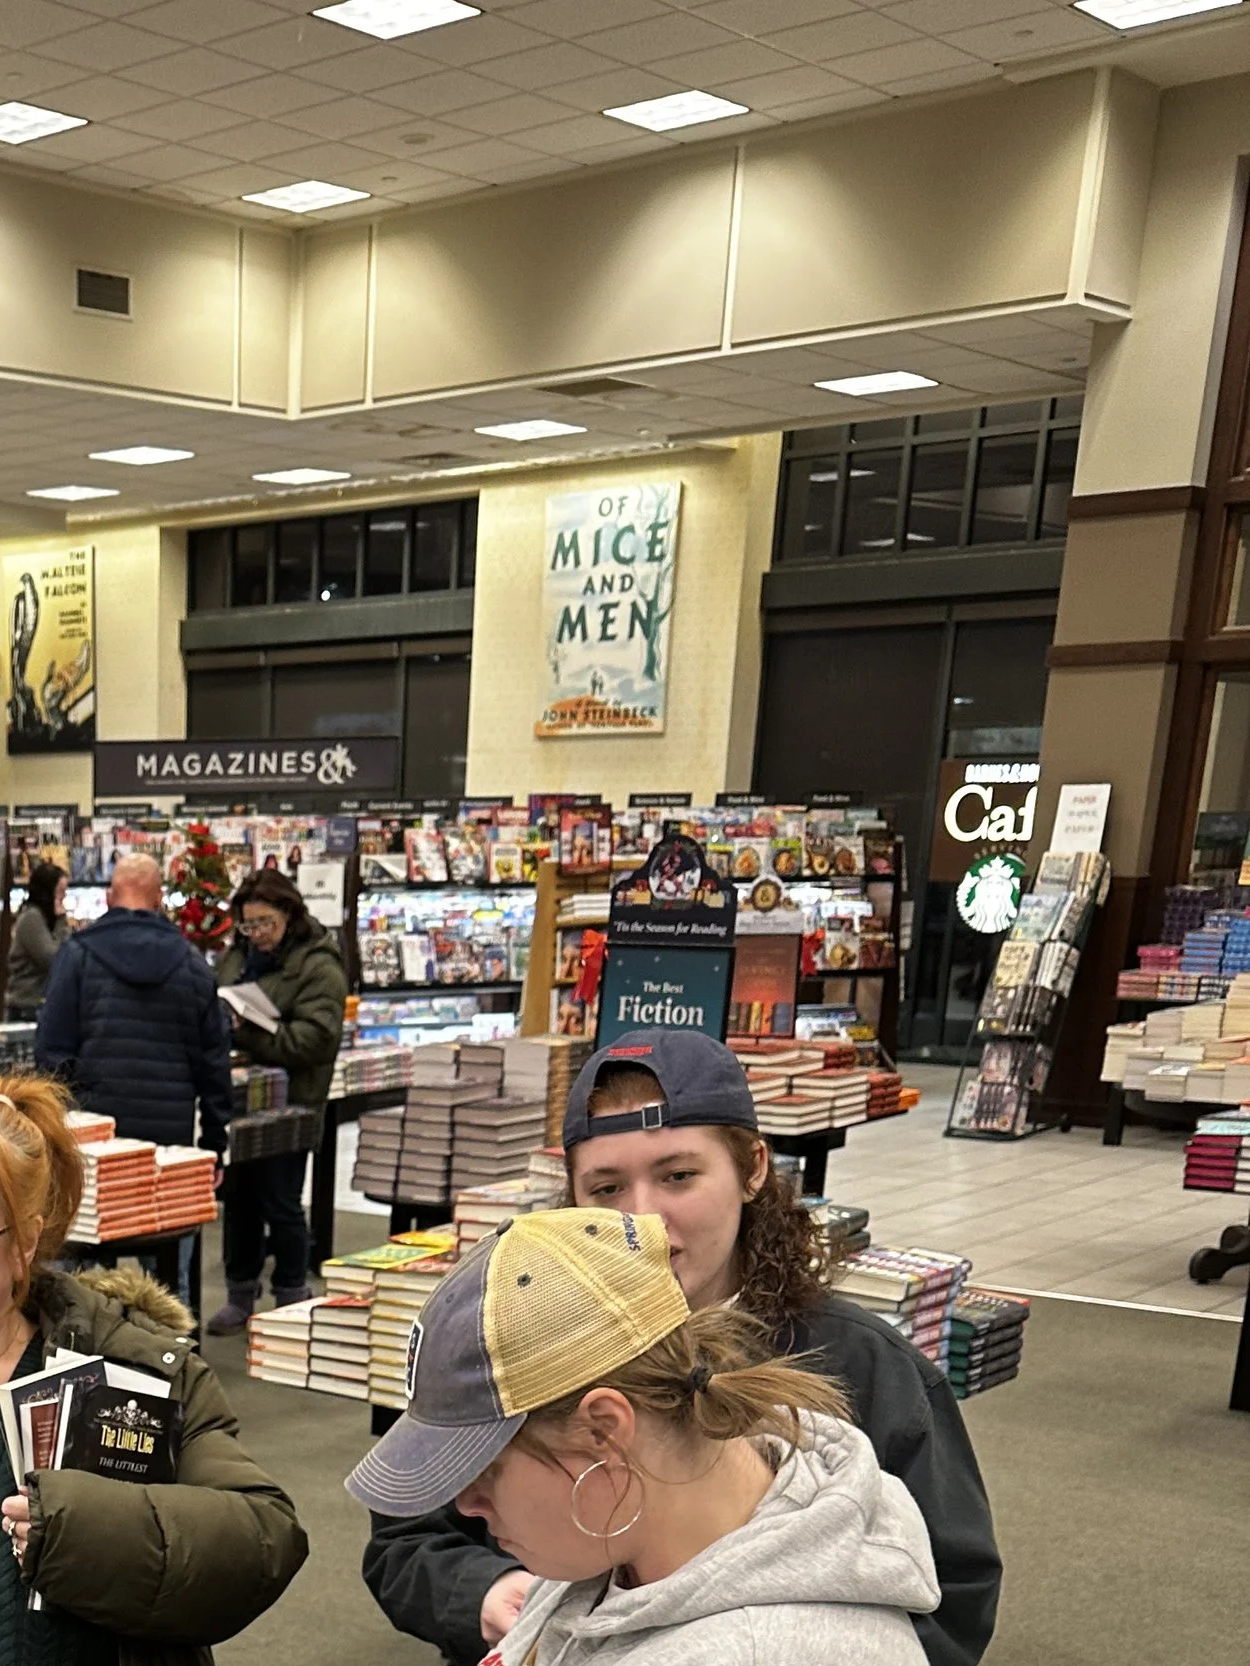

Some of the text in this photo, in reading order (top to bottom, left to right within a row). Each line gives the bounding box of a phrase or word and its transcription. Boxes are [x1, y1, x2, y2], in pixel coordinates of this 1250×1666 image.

[598, 495, 629, 517] OF
[550, 520, 670, 570] MICE
[44, 582, 87, 599] FALCON
[583, 573, 633, 597] AND
[557, 599, 655, 643] MEN
[583, 704, 658, 721] STEINBECK
[137, 751, 317, 777] MAGAZINES
[643, 981, 684, 994] The Best
[617, 996, 704, 1026] Fiction
[100, 1425, 117, 1448] The
[137, 1431, 155, 1455] Lies
[100, 1456, 113, 1468] THE
